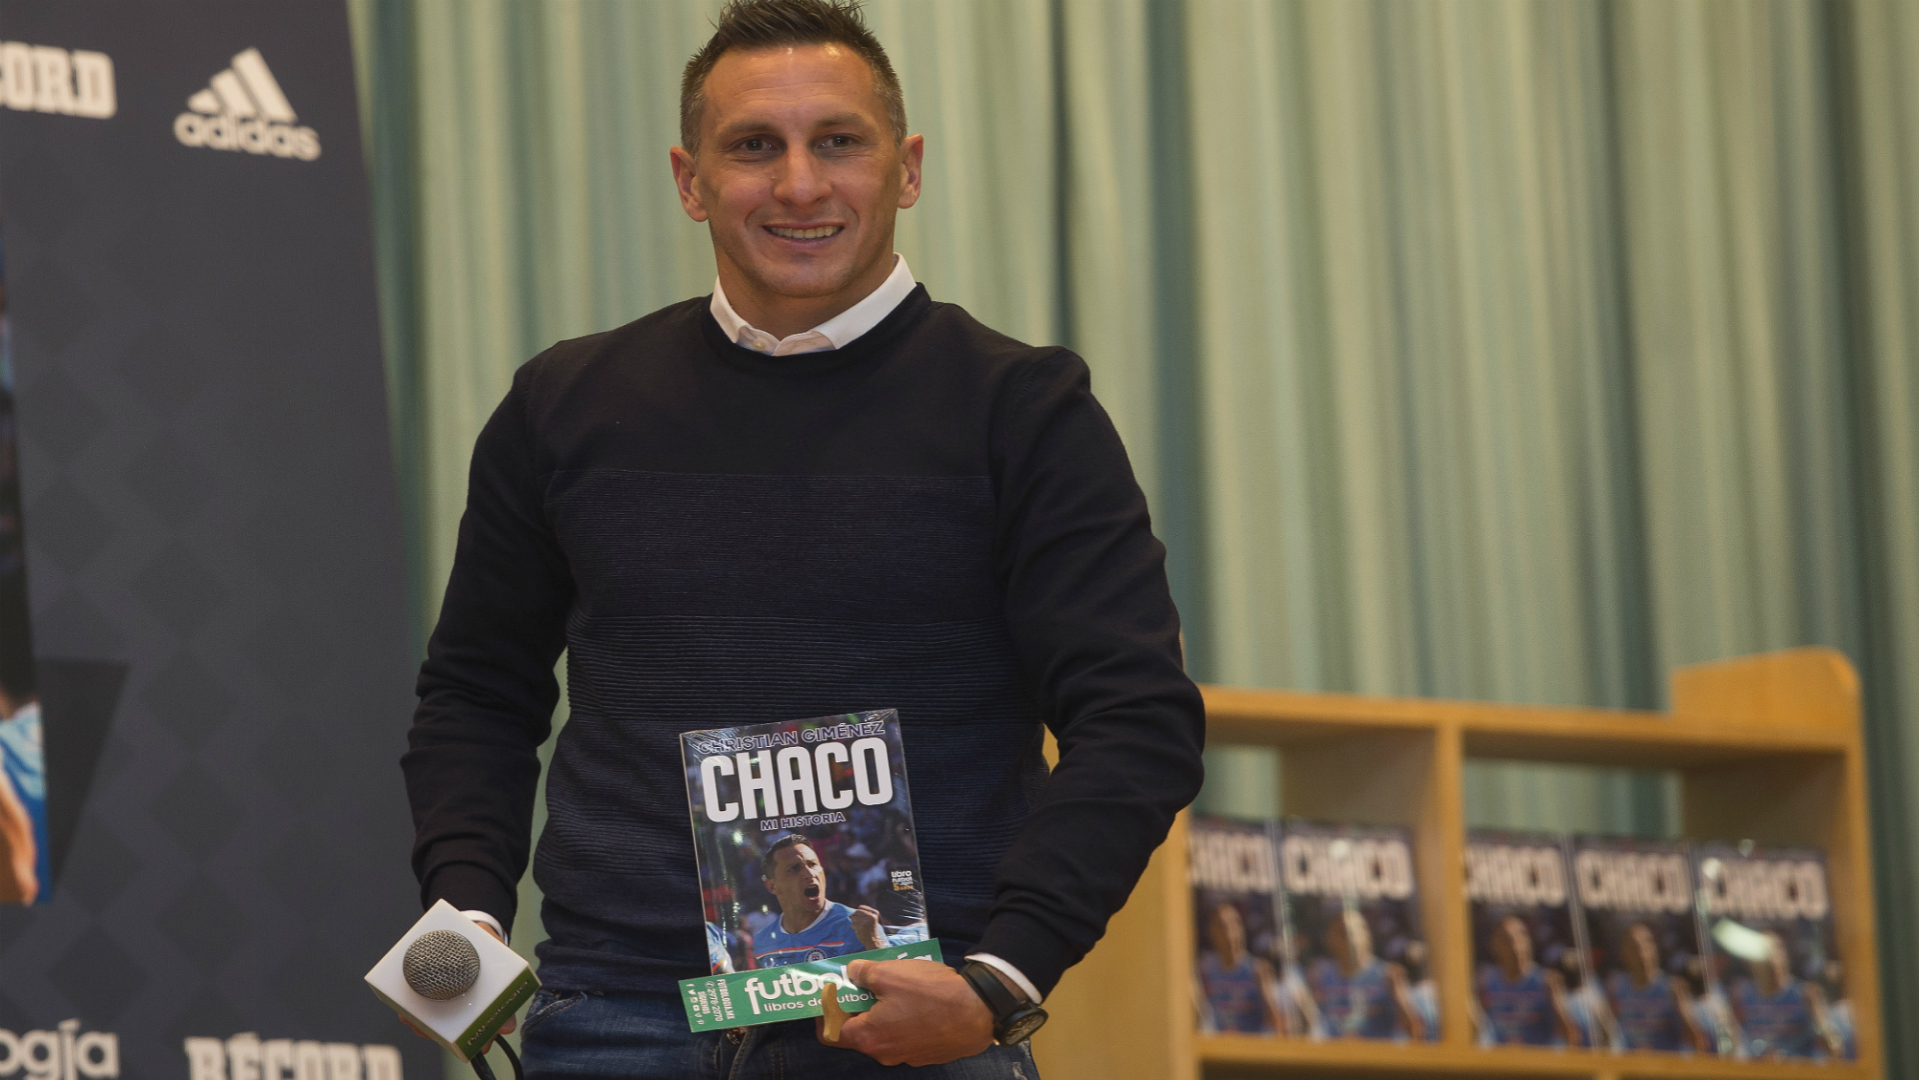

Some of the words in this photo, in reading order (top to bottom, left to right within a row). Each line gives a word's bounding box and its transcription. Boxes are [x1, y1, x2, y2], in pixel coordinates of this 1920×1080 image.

[0, 41, 118, 120] ORD
[173, 111, 322, 162] adidas
[699, 730, 798, 755] CHRISTIAN
[801, 720, 886, 743] GIMÉNEZ
[700, 737, 893, 823] CHACO
[760, 819, 778, 832] MI
[781, 811, 846, 829] HISTORIA
[1189, 829, 1275, 895] HACO
[1281, 833, 1415, 899] CHACO
[1576, 848, 1690, 916] CHACO
[744, 952, 933, 1015] futbol
[763, 1000, 805, 1013] libros
[836, 989, 875, 1005] utbol
[184, 1031, 405, 1080] RÉCORD
